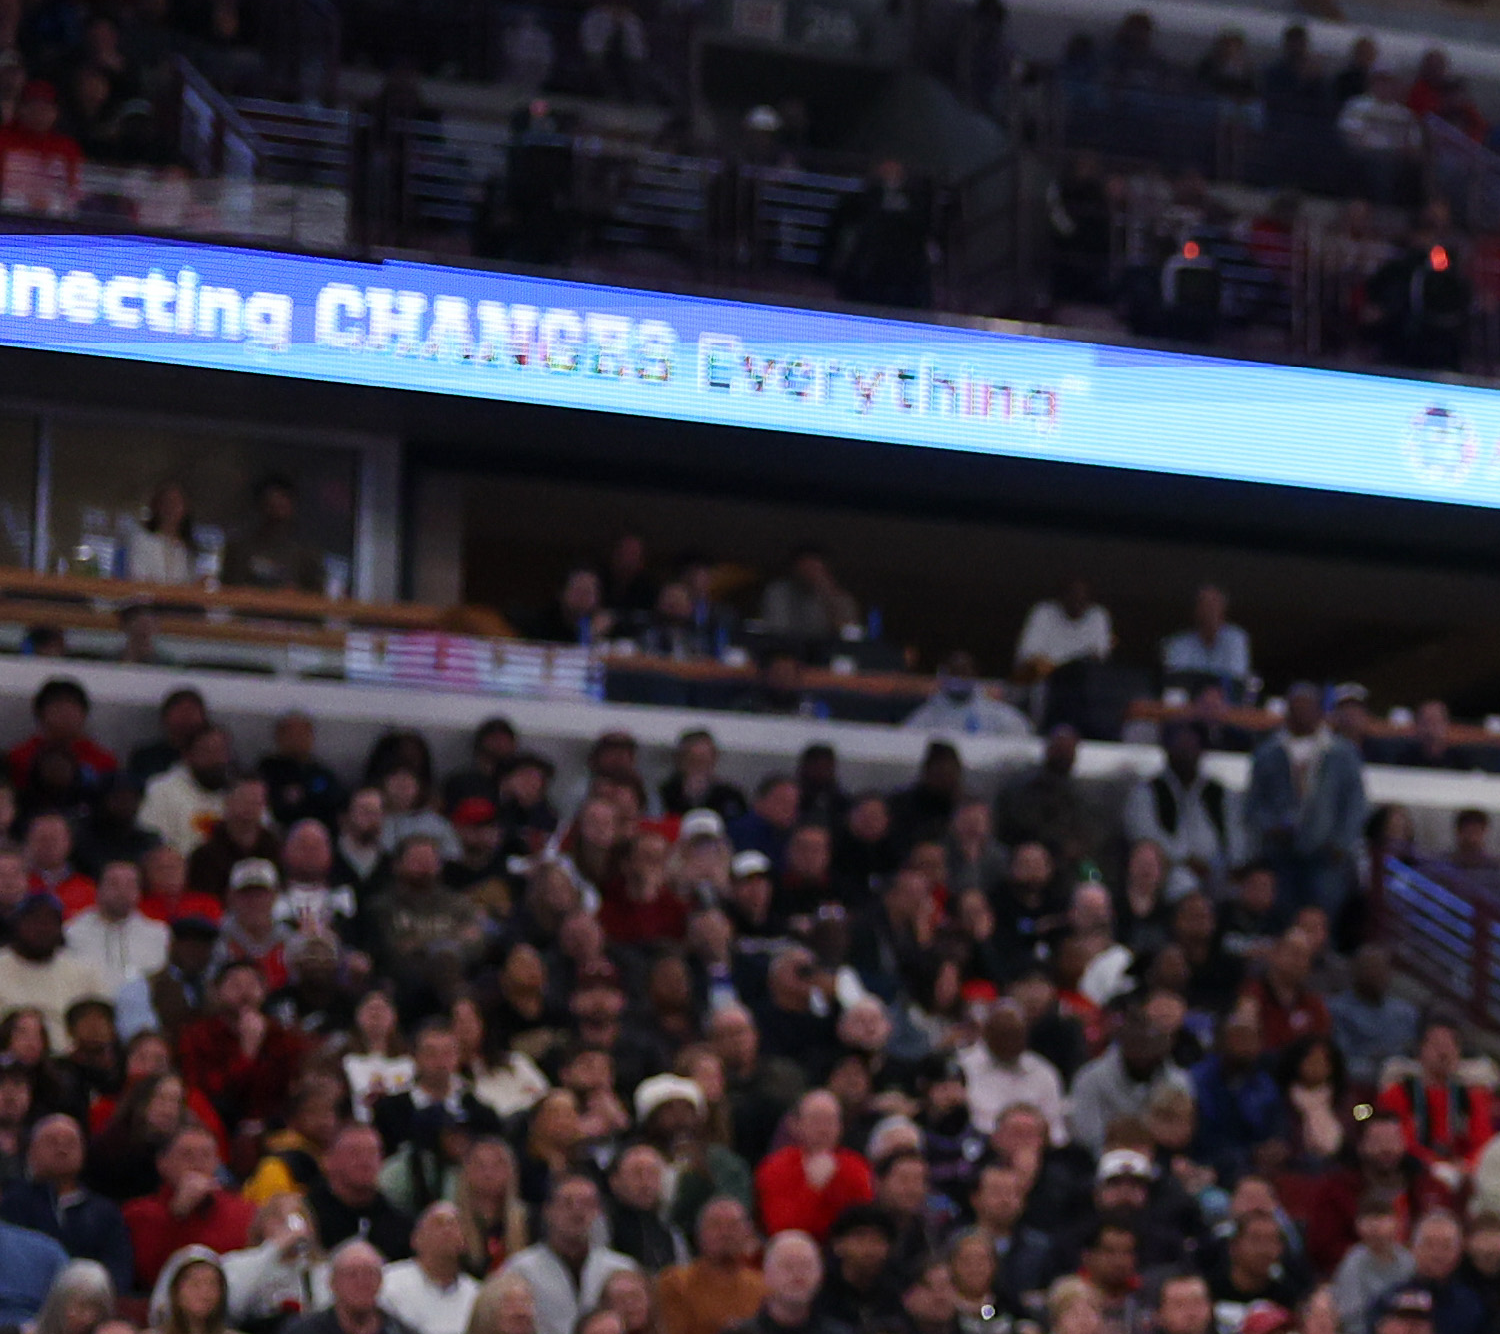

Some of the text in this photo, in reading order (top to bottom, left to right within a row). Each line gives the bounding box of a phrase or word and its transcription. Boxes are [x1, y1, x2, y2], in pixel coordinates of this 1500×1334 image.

[0, 262, 1058, 439] necting CHANGES Everything
